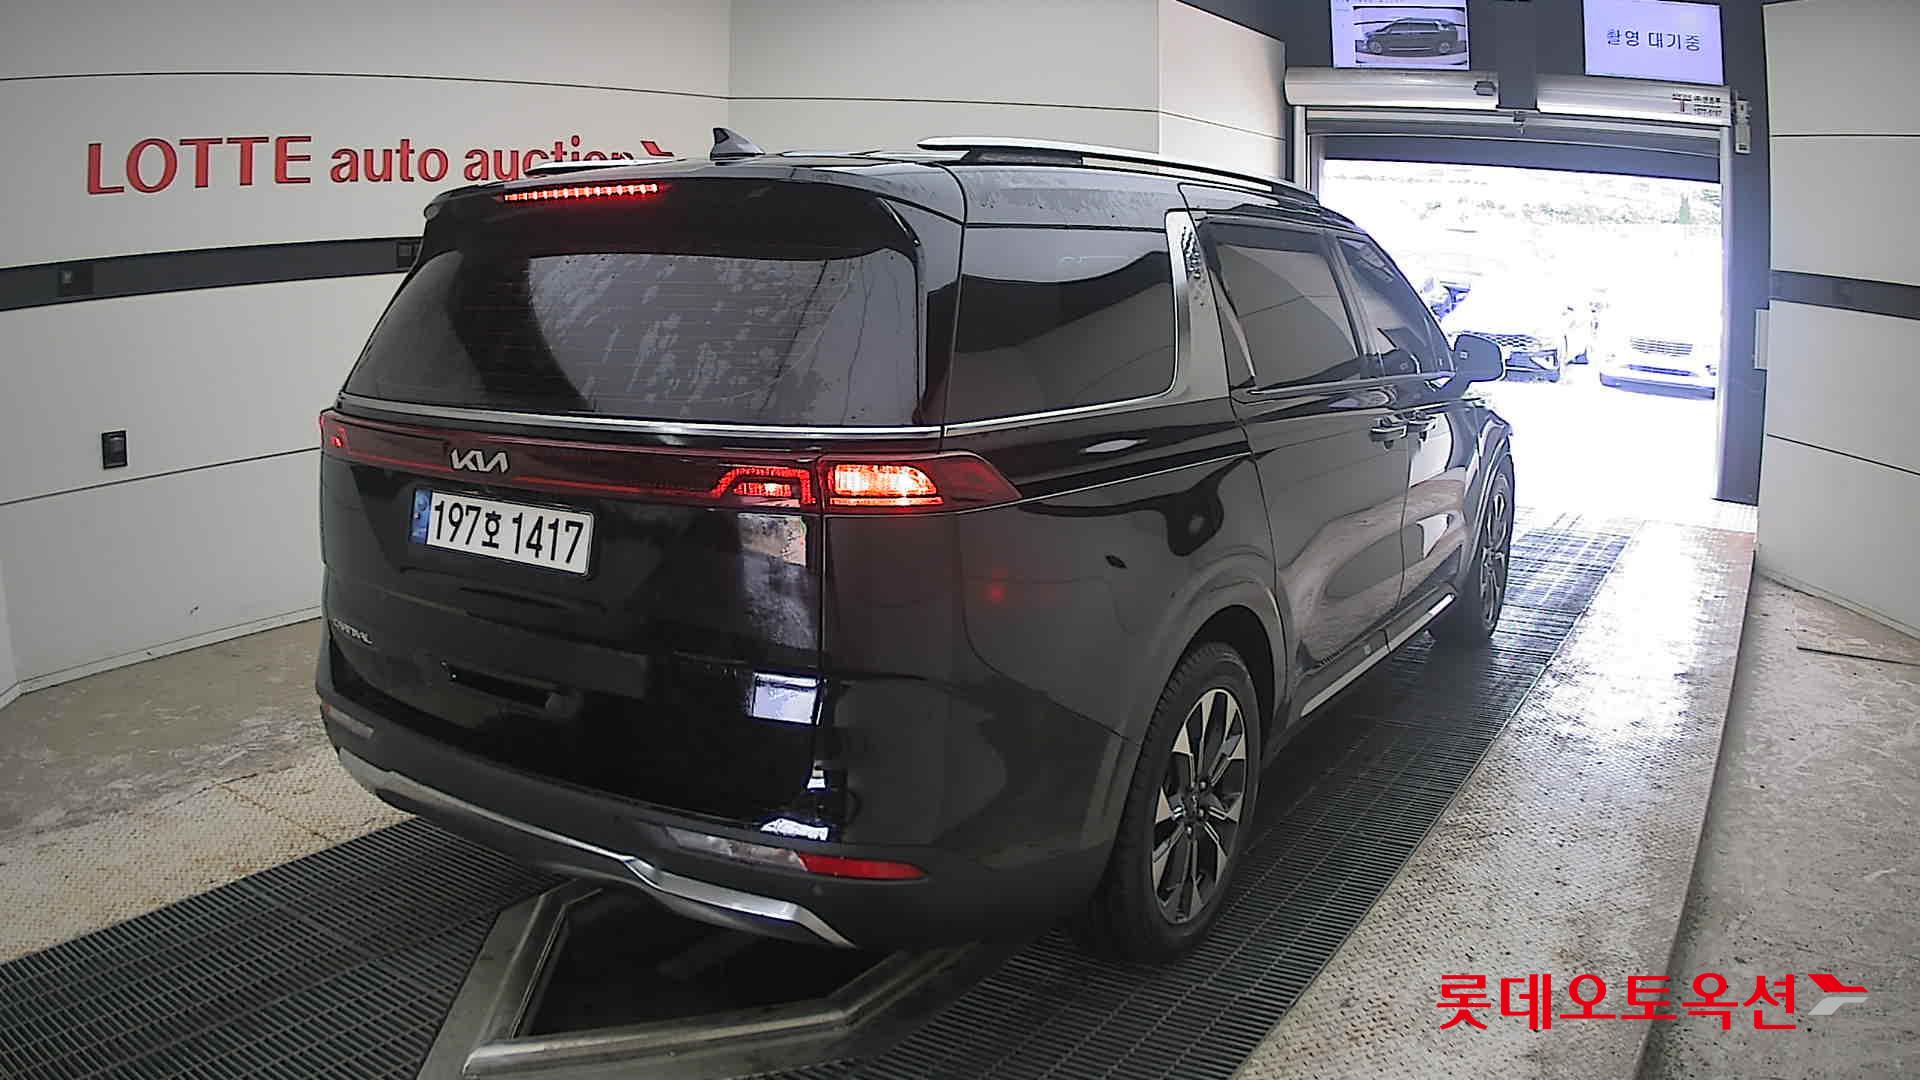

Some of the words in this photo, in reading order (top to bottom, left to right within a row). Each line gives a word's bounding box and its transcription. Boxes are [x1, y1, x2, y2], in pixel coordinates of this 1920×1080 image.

[1648, 31, 1701, 52] 대기중
[86, 135, 312, 195] LOTTE
[329, 138, 450, 183] auto
[462, 135, 634, 183] aucti
[450, 449, 511, 474] KIA
[433, 499, 503, 550] 197호
[511, 511, 585, 565] 1417
